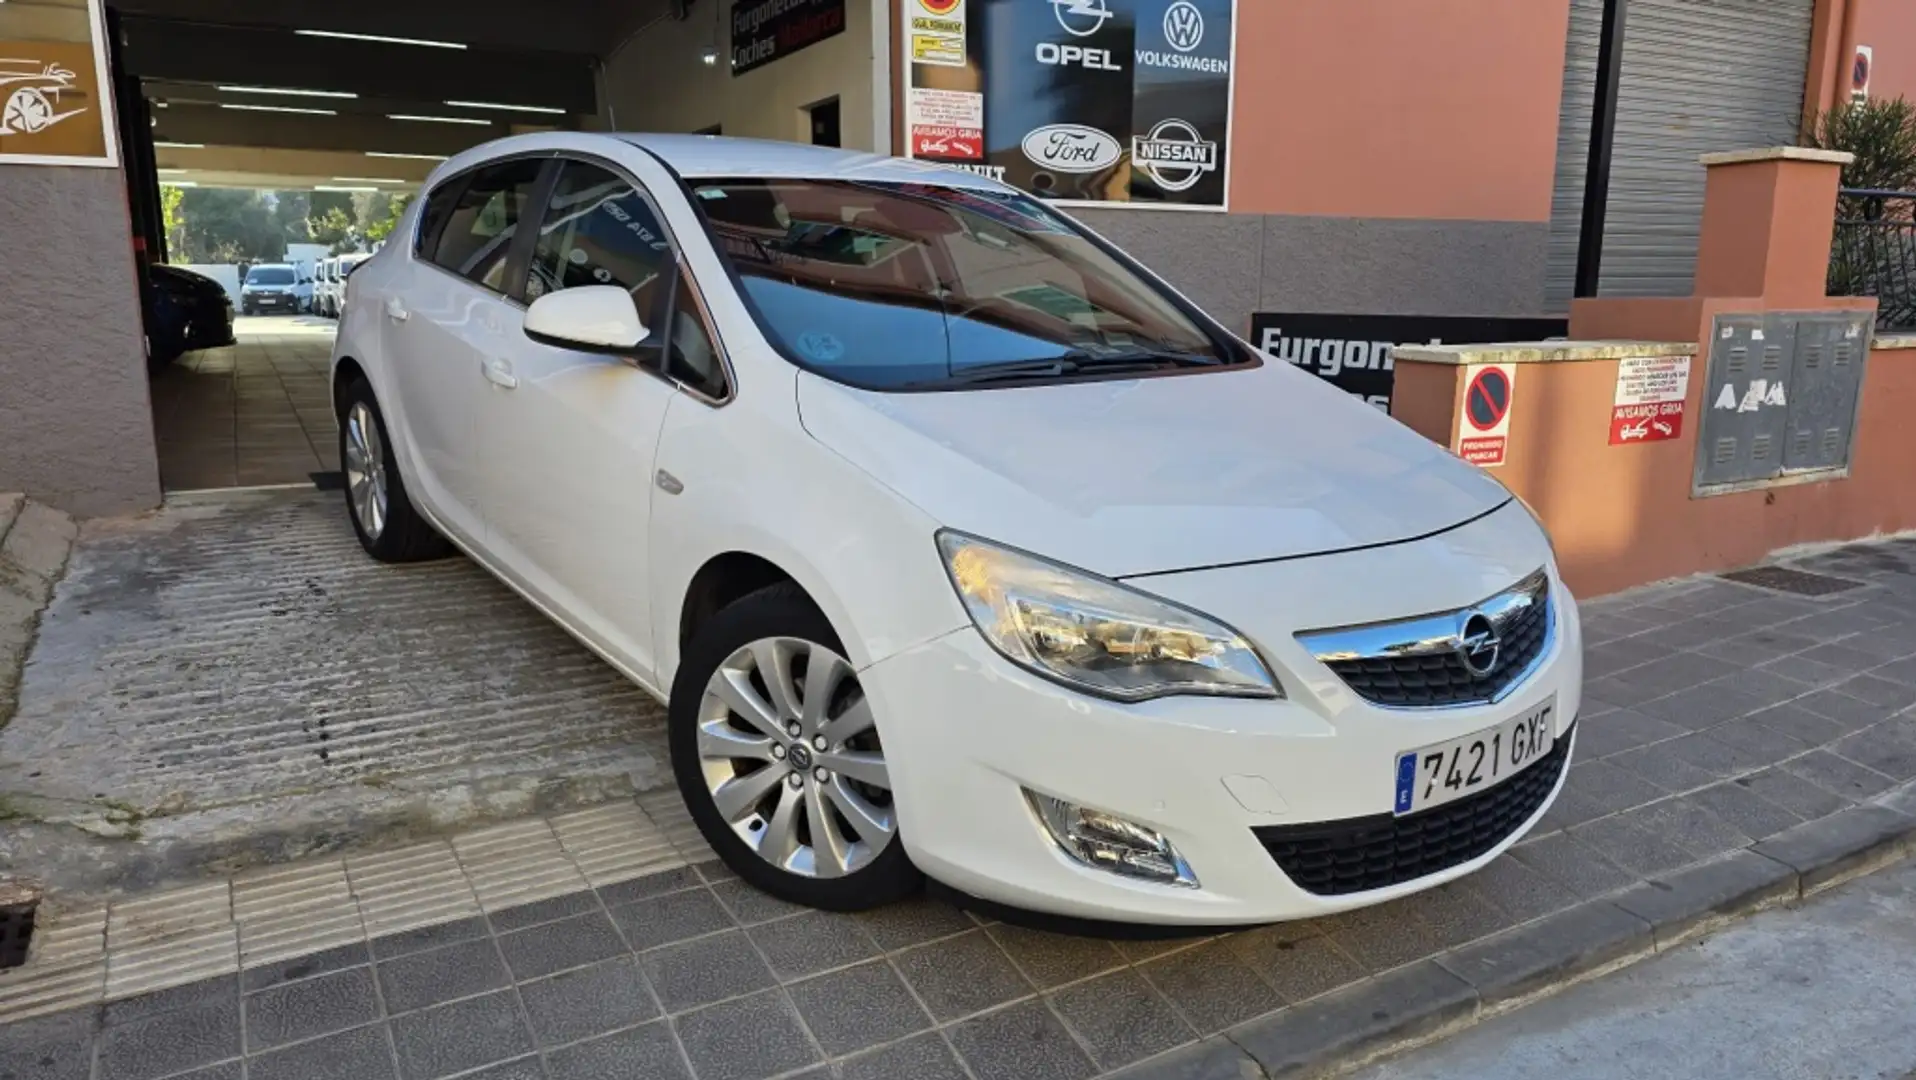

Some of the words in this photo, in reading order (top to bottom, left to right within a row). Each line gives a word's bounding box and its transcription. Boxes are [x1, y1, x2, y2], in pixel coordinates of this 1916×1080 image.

[734, 35, 776, 68] Coches
[1035, 43, 1122, 71] OPEL
[1135, 50, 1229, 74] VOLKSWAGEN
[1044, 131, 1100, 162] Ford
[1141, 143, 1206, 161] NISSAN
[1615, 404, 1659, 418] AVISAMOS
[1424, 733, 1501, 800] 7421
[1511, 706, 1552, 765] GXF
